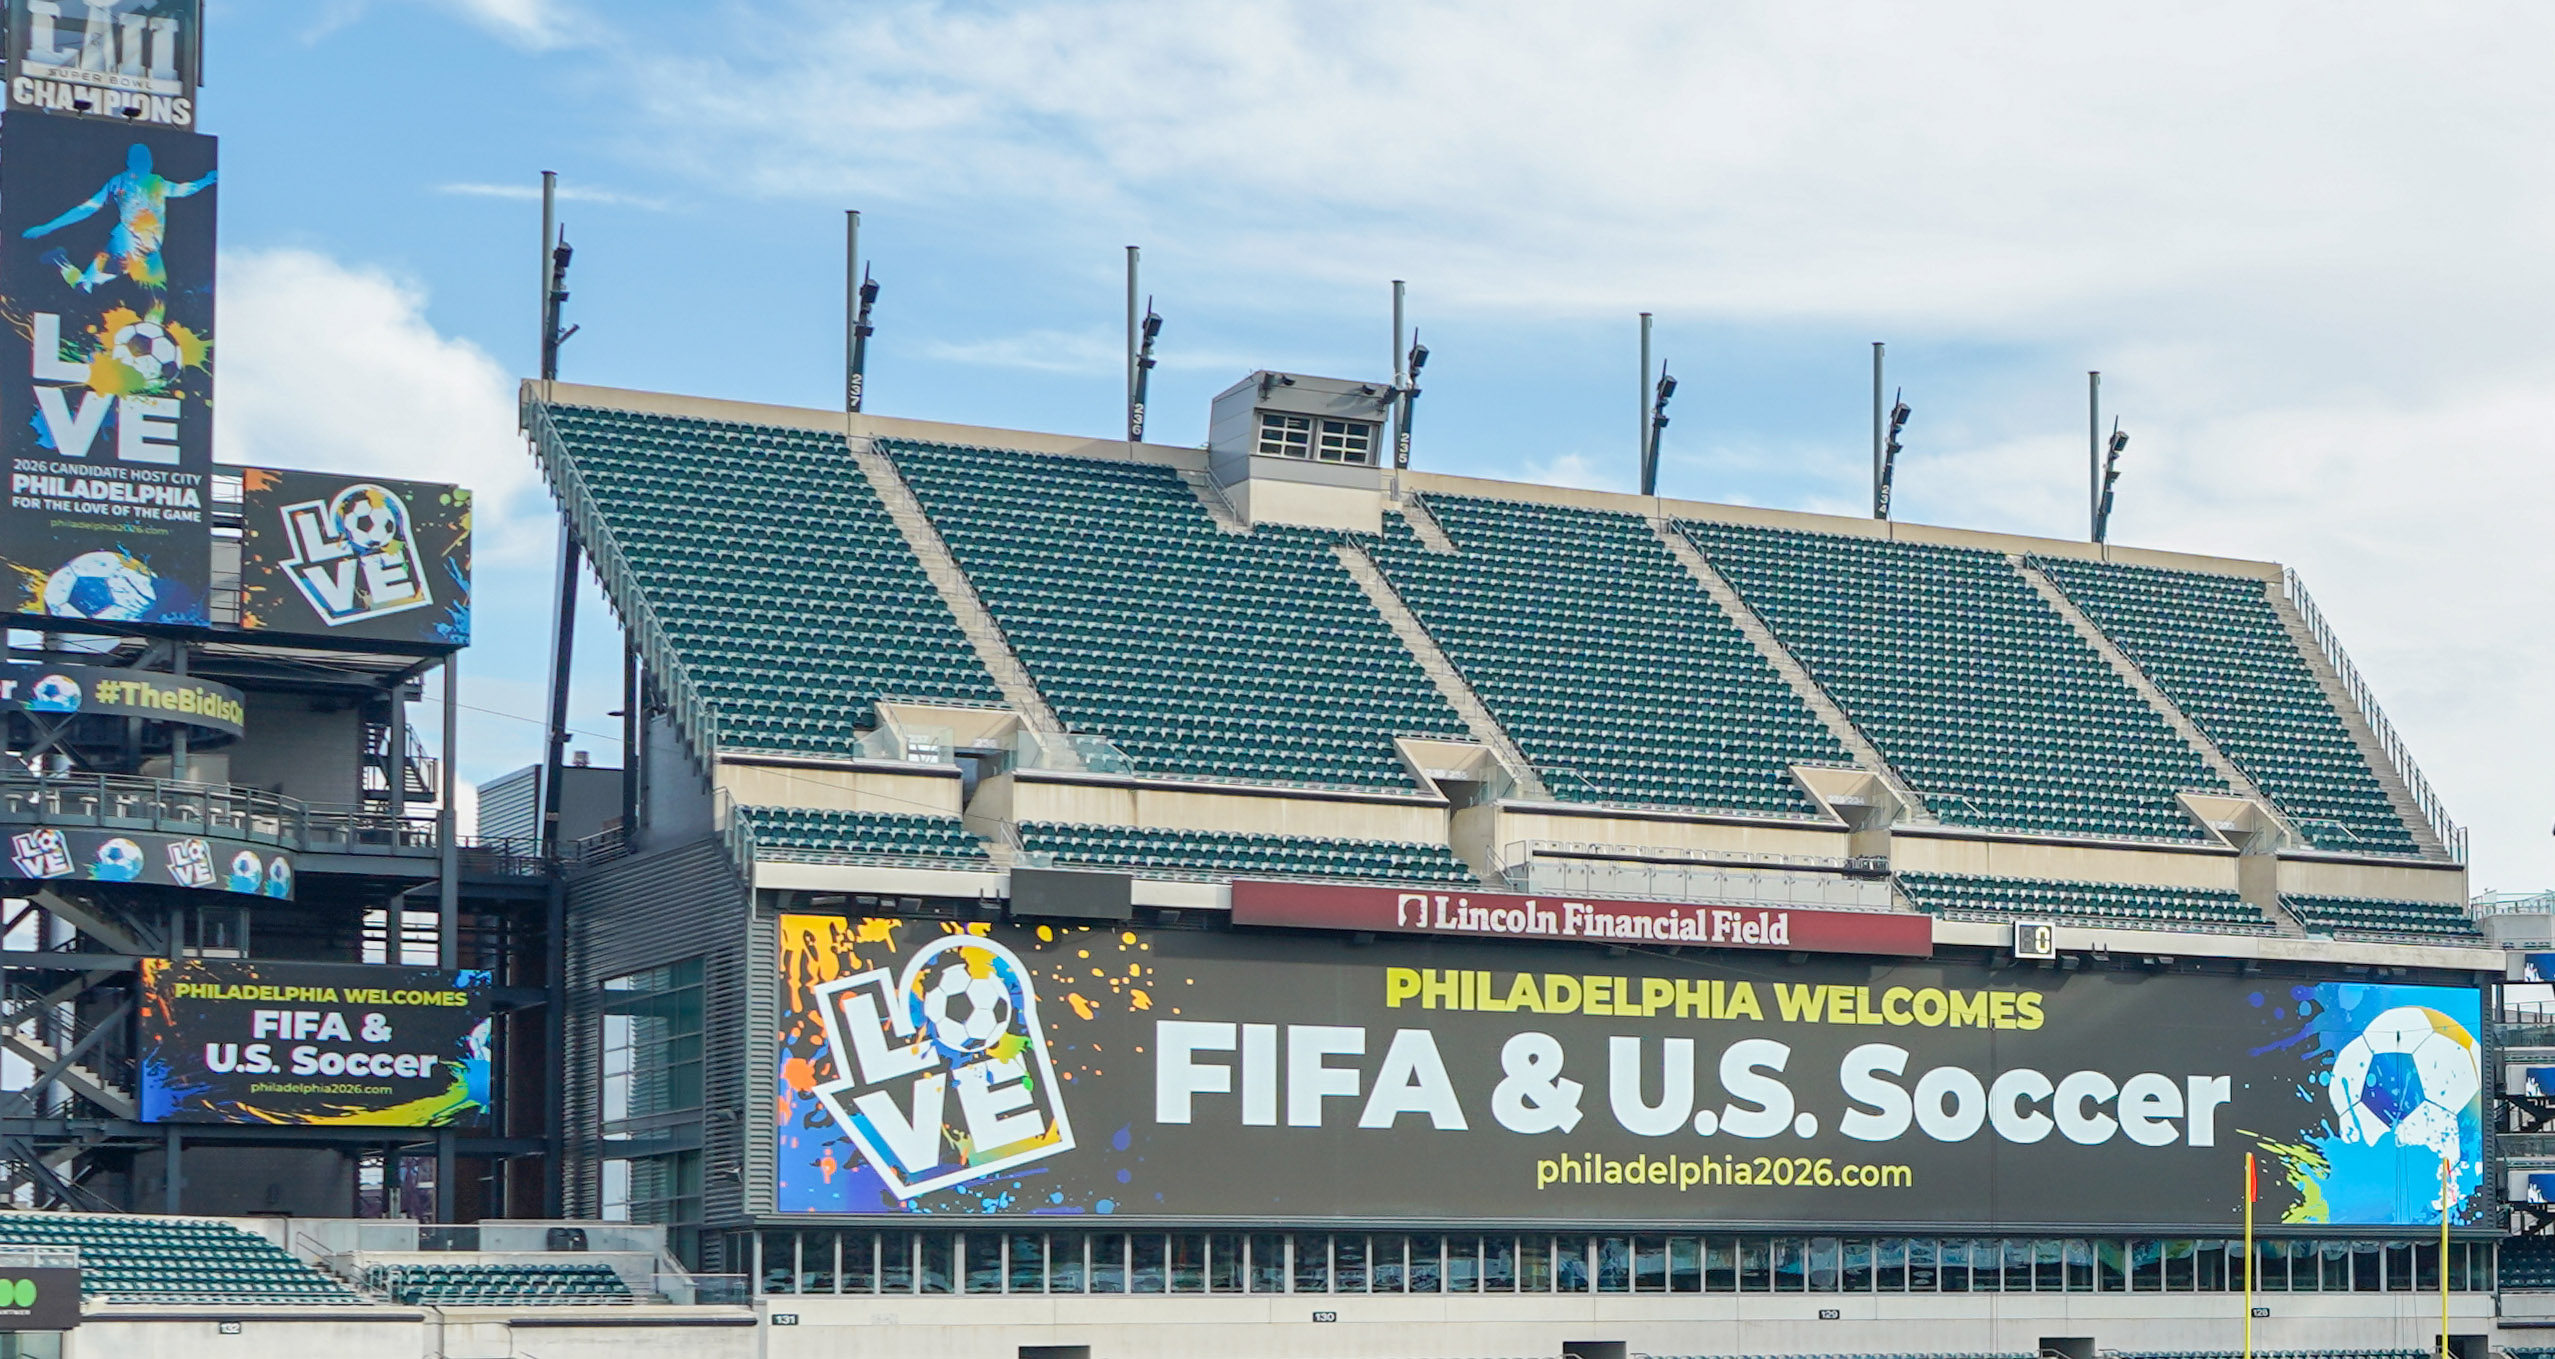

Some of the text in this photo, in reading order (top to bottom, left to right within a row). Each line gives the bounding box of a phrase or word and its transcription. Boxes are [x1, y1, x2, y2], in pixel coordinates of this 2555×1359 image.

[47, 68, 154, 90] SUPER BOWL
[12, 76, 192, 126] CHAMPIONS
[850, 373, 862, 407] 237
[1132, 402, 1144, 436] 236
[1398, 432, 1410, 464] 235
[13, 458, 203, 486] 2026 CANDIDATE HOST CITY
[12, 473, 202, 509] PHILADELPHIA
[1878, 484, 1890, 514] 234
[12, 496, 202, 523] FOR THE LOVE OF THE GAME
[1434, 894, 1791, 946] Lincoln Financial Field
[174, 983, 469, 1007] PHILADELPHIA WELCOMES
[1386, 967, 2046, 1031] PHILADELPHIA WELCOMES
[252, 1009, 393, 1043] FIFA &
[206, 1043, 439, 1078] U.S. Soccer
[251, 1082, 393, 1096] philadelphia2026.com
[1155, 1020, 2232, 1147] FIFA & U.S. Soccer
[1537, 1152, 1913, 1192] philadelphia2026.com
[776, 1315, 796, 1325] 131
[1315, 1312, 1335, 1322] 130
